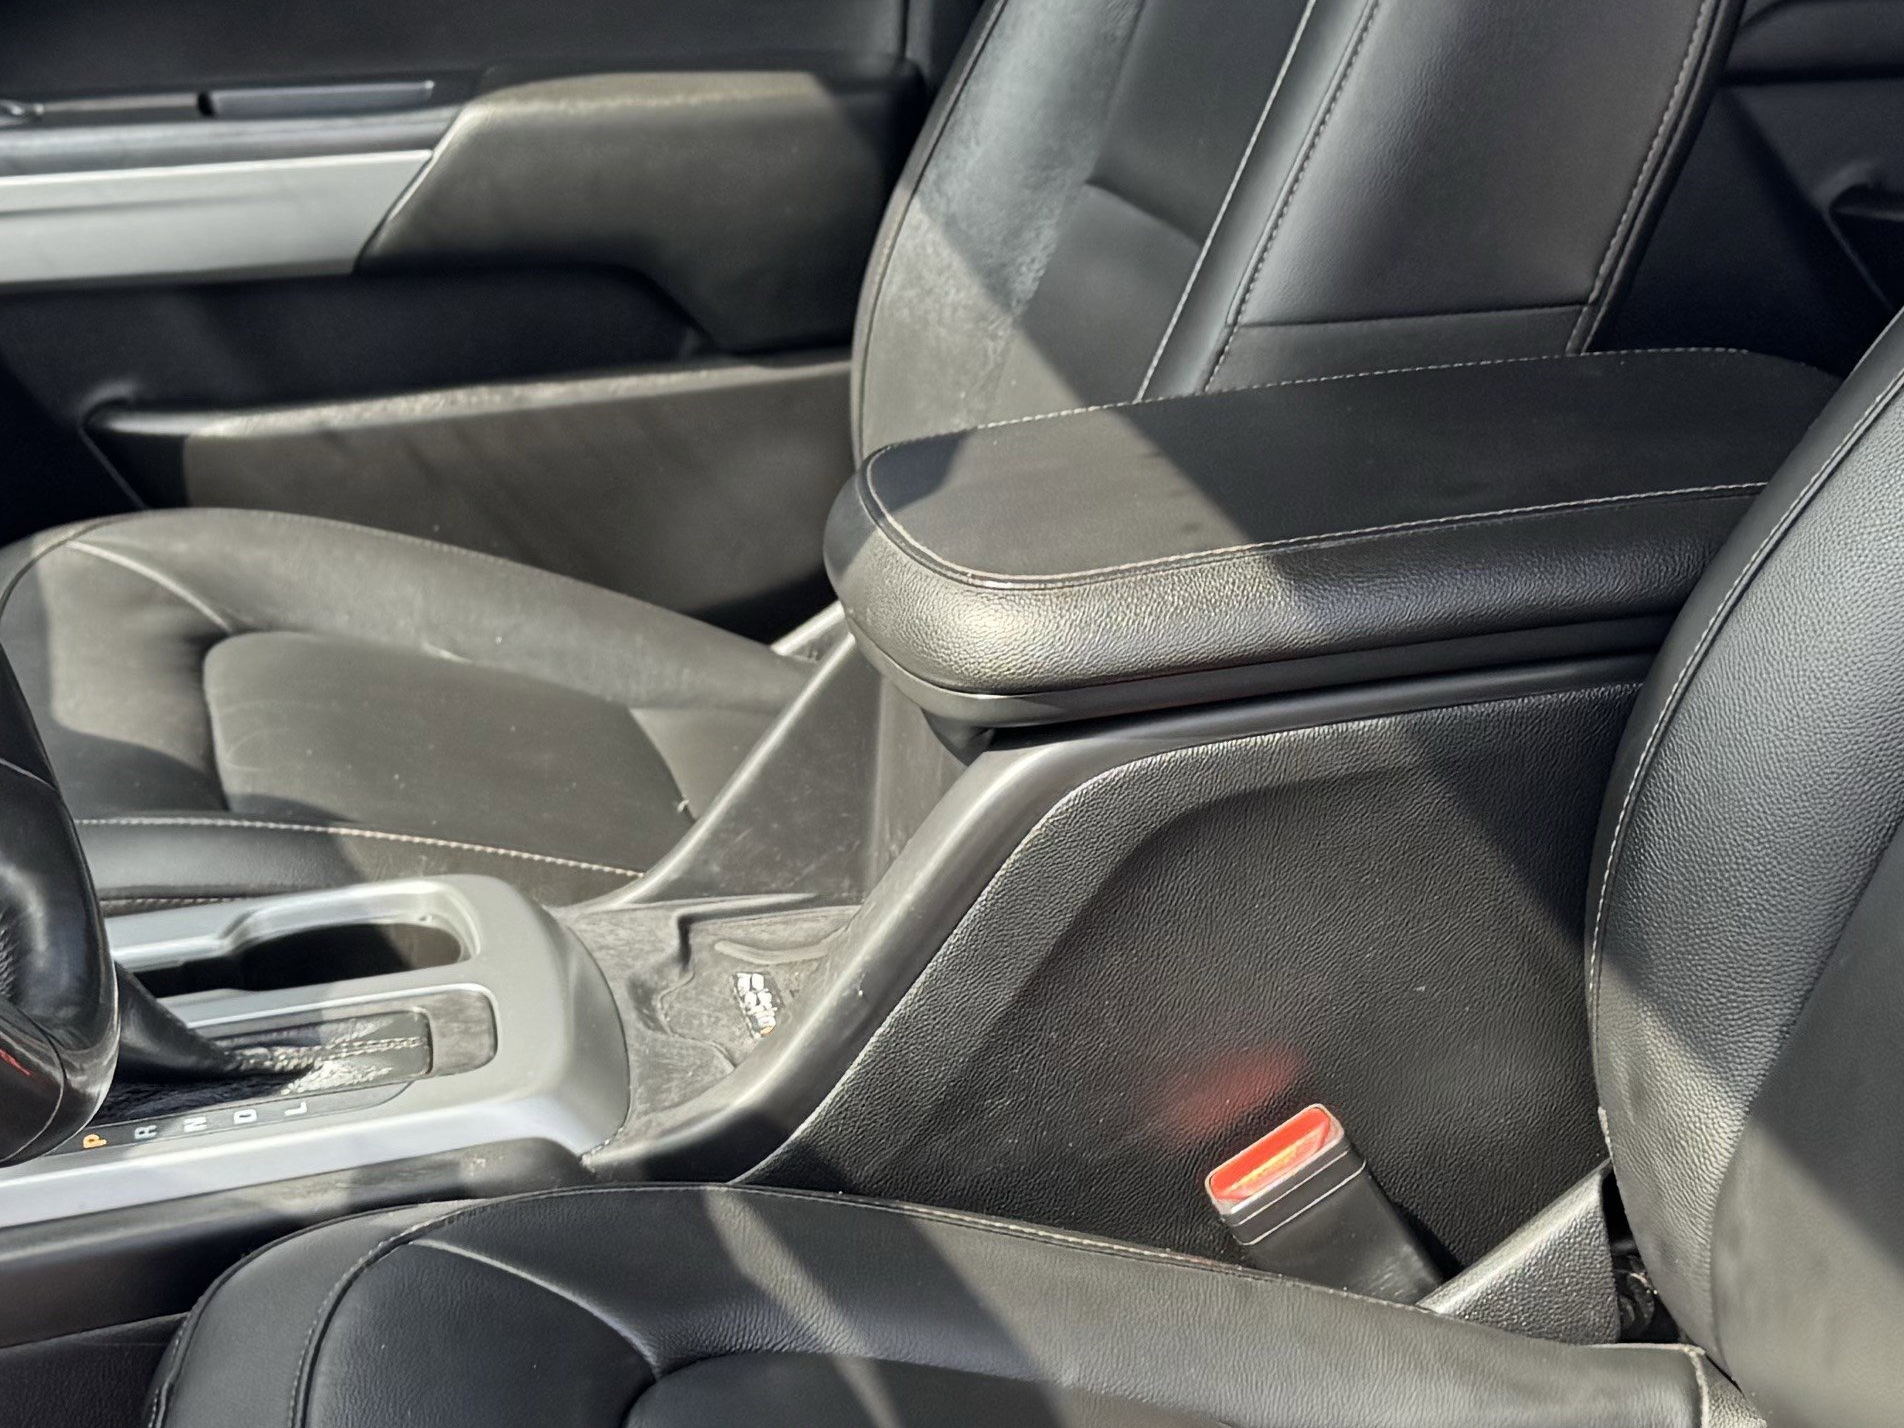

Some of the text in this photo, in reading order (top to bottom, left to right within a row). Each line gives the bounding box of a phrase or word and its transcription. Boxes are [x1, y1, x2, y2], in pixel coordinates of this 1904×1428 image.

[81, 1101, 308, 1149] P R N D L
